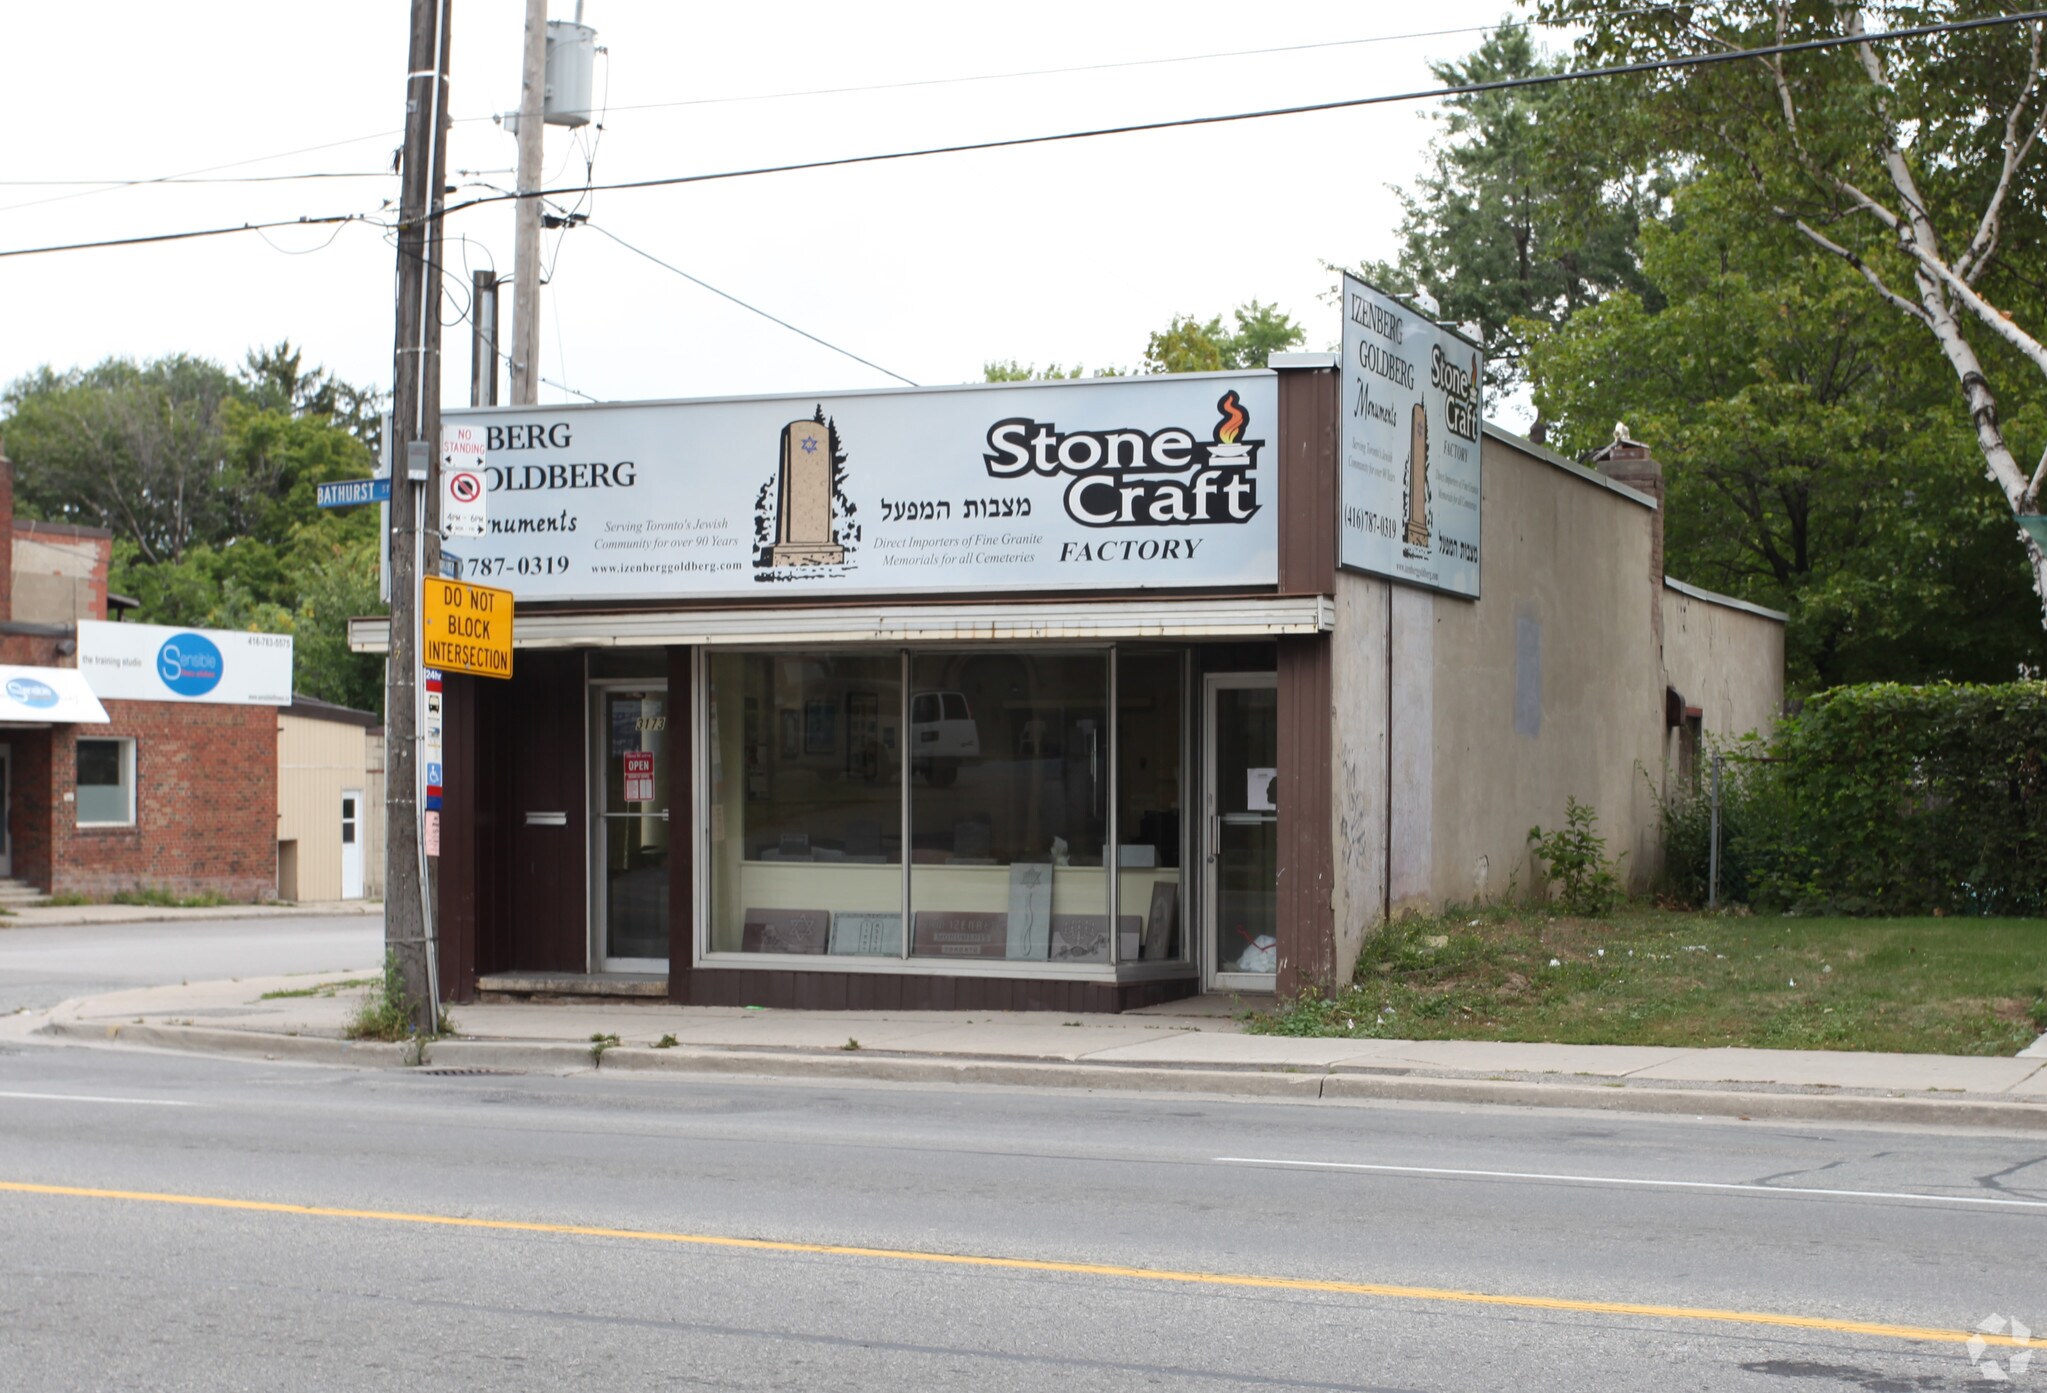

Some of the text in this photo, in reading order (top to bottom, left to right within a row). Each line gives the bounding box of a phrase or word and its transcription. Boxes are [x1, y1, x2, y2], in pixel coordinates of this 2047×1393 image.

[1351, 292, 1403, 345] IZENBERG
[1359, 339, 1414, 391] GOLDBERG
[1432, 347, 1469, 399] Stone
[1354, 377, 1397, 428] Monuments
[1445, 394, 1477, 442] Craft
[458, 428, 472, 440] NO
[487, 422, 573, 451] BERG
[443, 442, 485, 456] STANDING
[989, 421, 1193, 475] Stone
[1443, 440, 1468, 464] FACTORY
[485, 461, 637, 492] OLDBERG
[317, 482, 390, 505] BATHURST ST
[1068, 467, 1252, 524] Craft
[488, 509, 577, 534] numents
[881, 497, 1032, 522] מצבות המפעל
[604, 517, 728, 533] Serving Toronto's Jewish
[594, 535, 738, 550] Community for over 90 Years
[874, 533, 1043, 550] Direct Importers of Fine Granite
[1058, 538, 1206, 562] FACTORY
[592, 560, 742, 575] www.izenberggoldberg.com
[883, 551, 1035, 567] Memorials for all Cemeteries
[444, 585, 495, 613] DO NOT
[448, 613, 490, 640] BLOCK
[82, 655, 142, 668] the training studio
[428, 640, 508, 671] INTERSECTION
[426, 669, 441, 681] 24hr
[637, 717, 664, 730] 3173
[628, 760, 649, 771] OPEN
